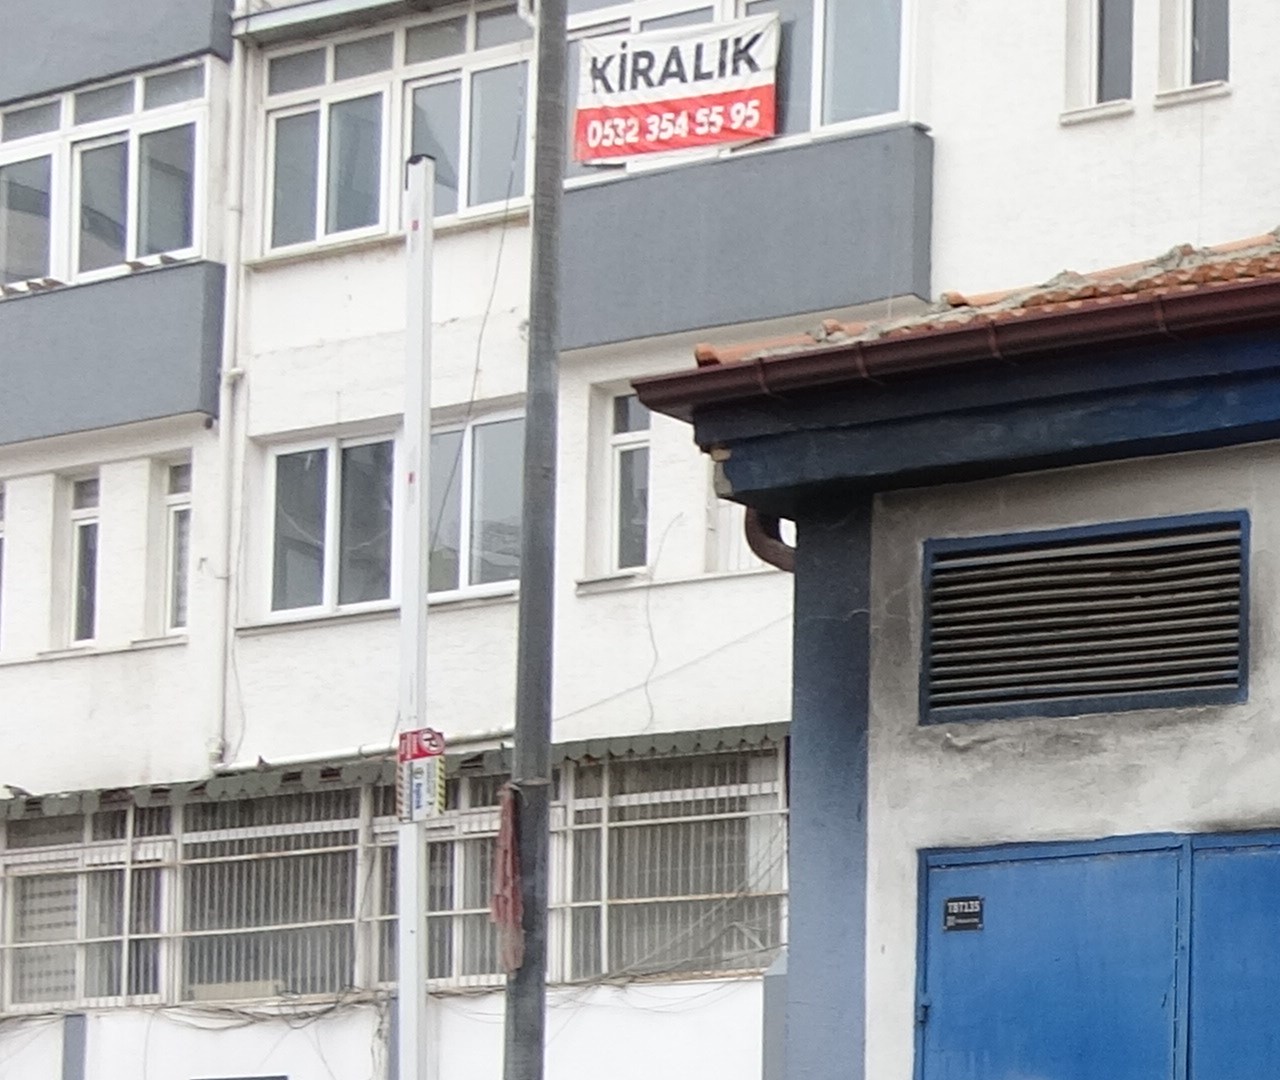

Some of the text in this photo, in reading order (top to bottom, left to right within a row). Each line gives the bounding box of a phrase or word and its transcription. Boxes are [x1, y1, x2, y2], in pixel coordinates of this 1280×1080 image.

[591, 32, 763, 94] KİRALIK
[645, 109, 688, 142] 354
[695, 105, 723, 134] 55
[730, 99, 760, 128] 95
